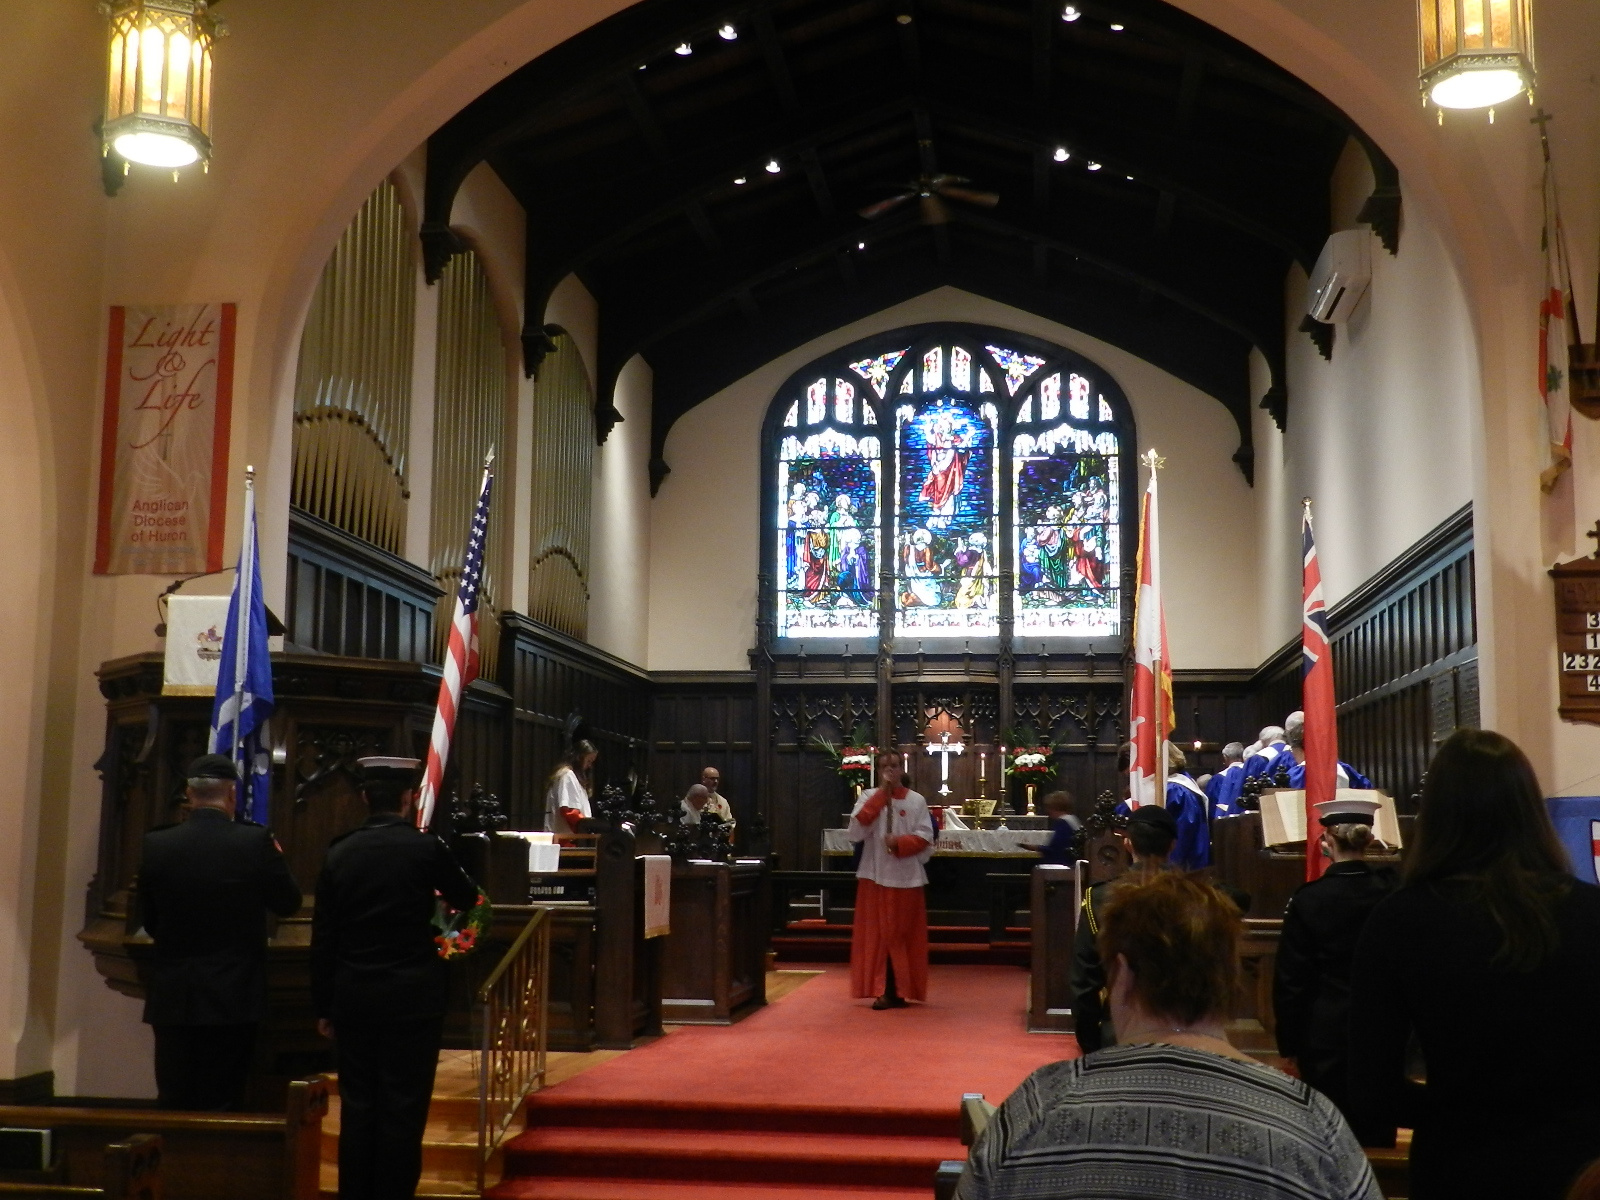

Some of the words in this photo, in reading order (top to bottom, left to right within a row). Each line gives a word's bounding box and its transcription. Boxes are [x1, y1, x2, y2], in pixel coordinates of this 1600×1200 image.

[128, 304, 215, 381] Light
[129, 358, 216, 449] Life
[132, 499, 189, 514] Anglican
[133, 514, 186, 527] Diocese
[131, 530, 143, 542] of
[148, 531, 187, 542] Huron
[1589, 612, 1600, 628] 3
[1565, 653, 1600, 670] 232
[1589, 675, 1600, 691] 4
